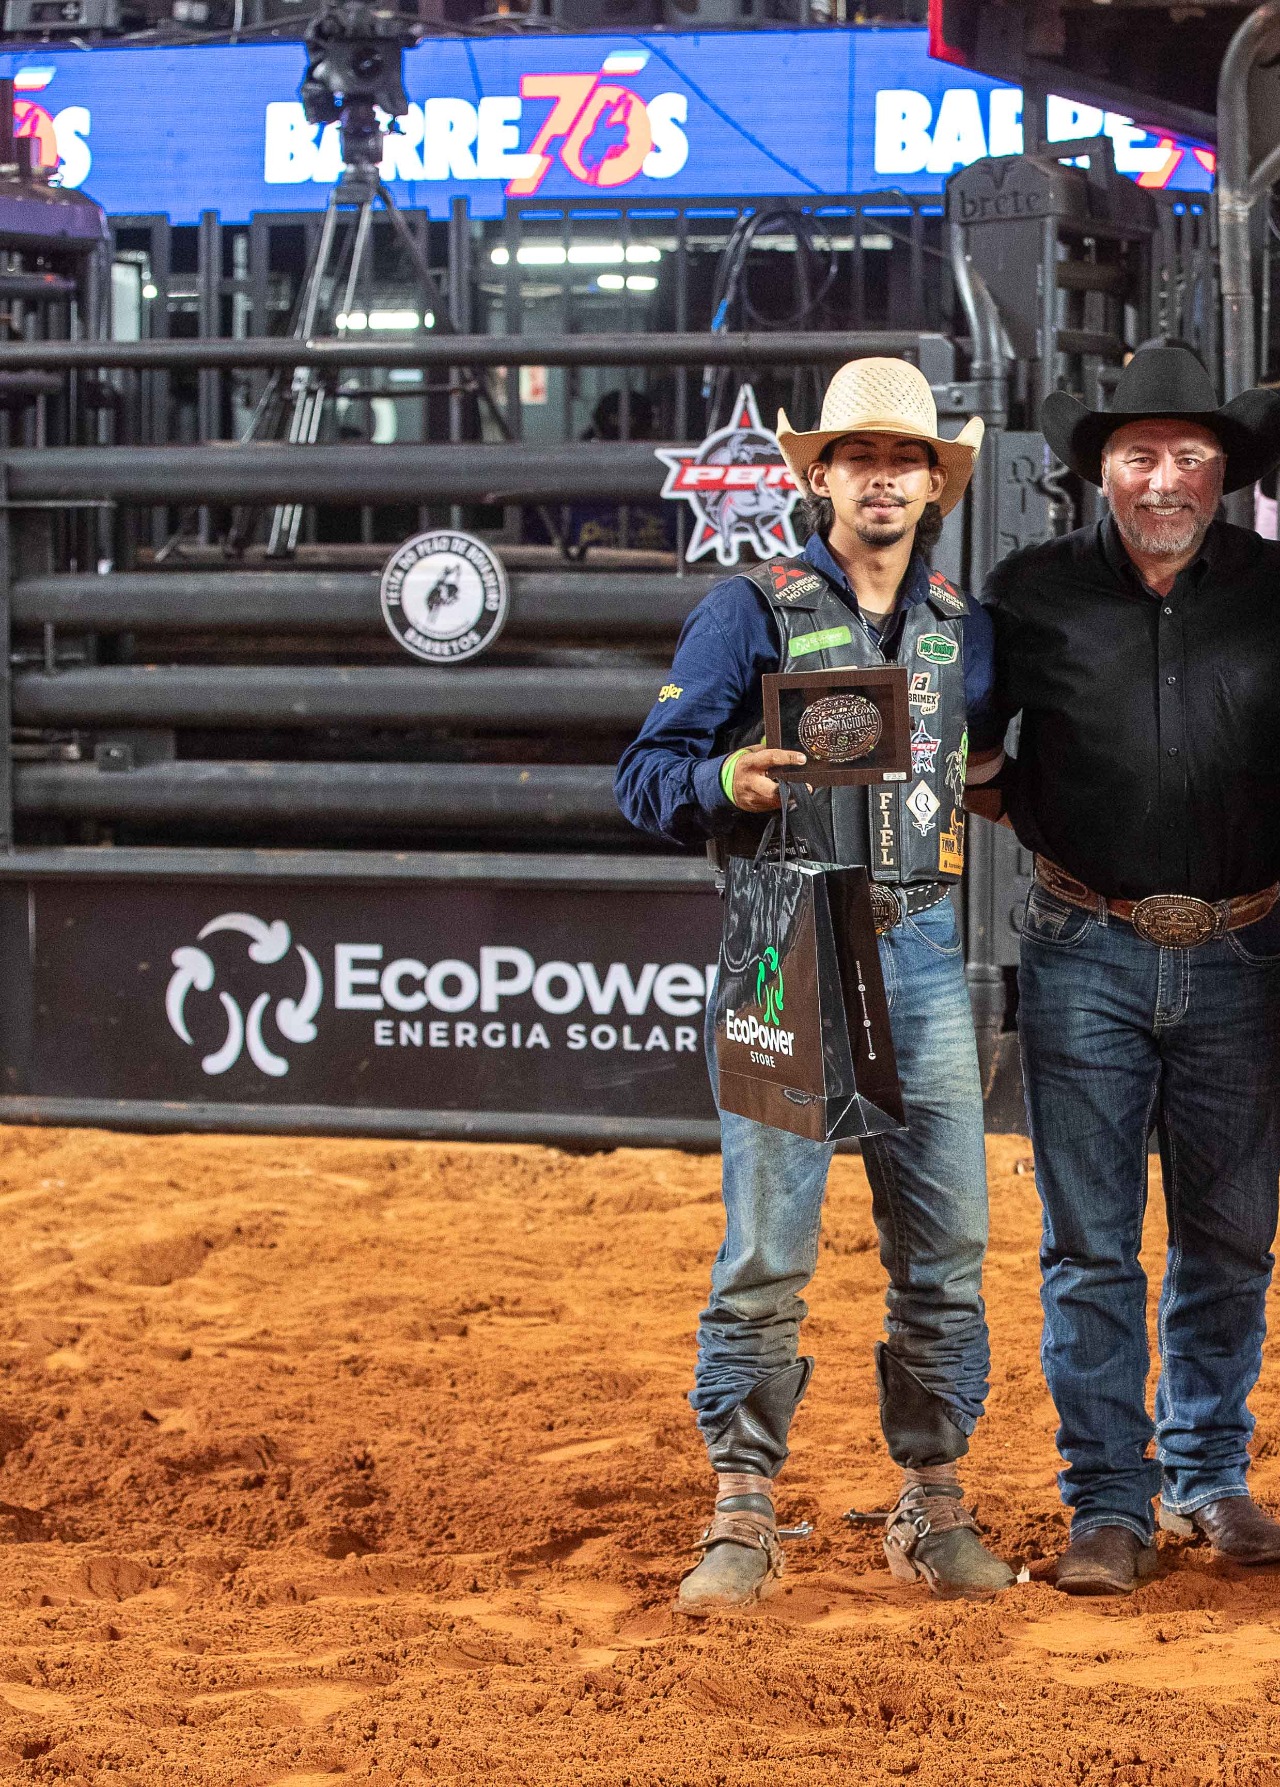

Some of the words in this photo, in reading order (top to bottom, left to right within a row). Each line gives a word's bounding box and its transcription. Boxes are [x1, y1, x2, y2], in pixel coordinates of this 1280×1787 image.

[775, 574, 819, 600] MITSUBISHI
[786, 581, 820, 602] MOTORS
[929, 583, 964, 608] ITSUBISHI
[909, 693, 937, 705] BRIMEX
[879, 792, 894, 866] FIEL
[373, 1019, 551, 1049] ENERGIA
[566, 1022, 698, 1052] SOLAR
[726, 1008, 795, 1057] EcoPower
[750, 1050, 776, 1068] STORE
